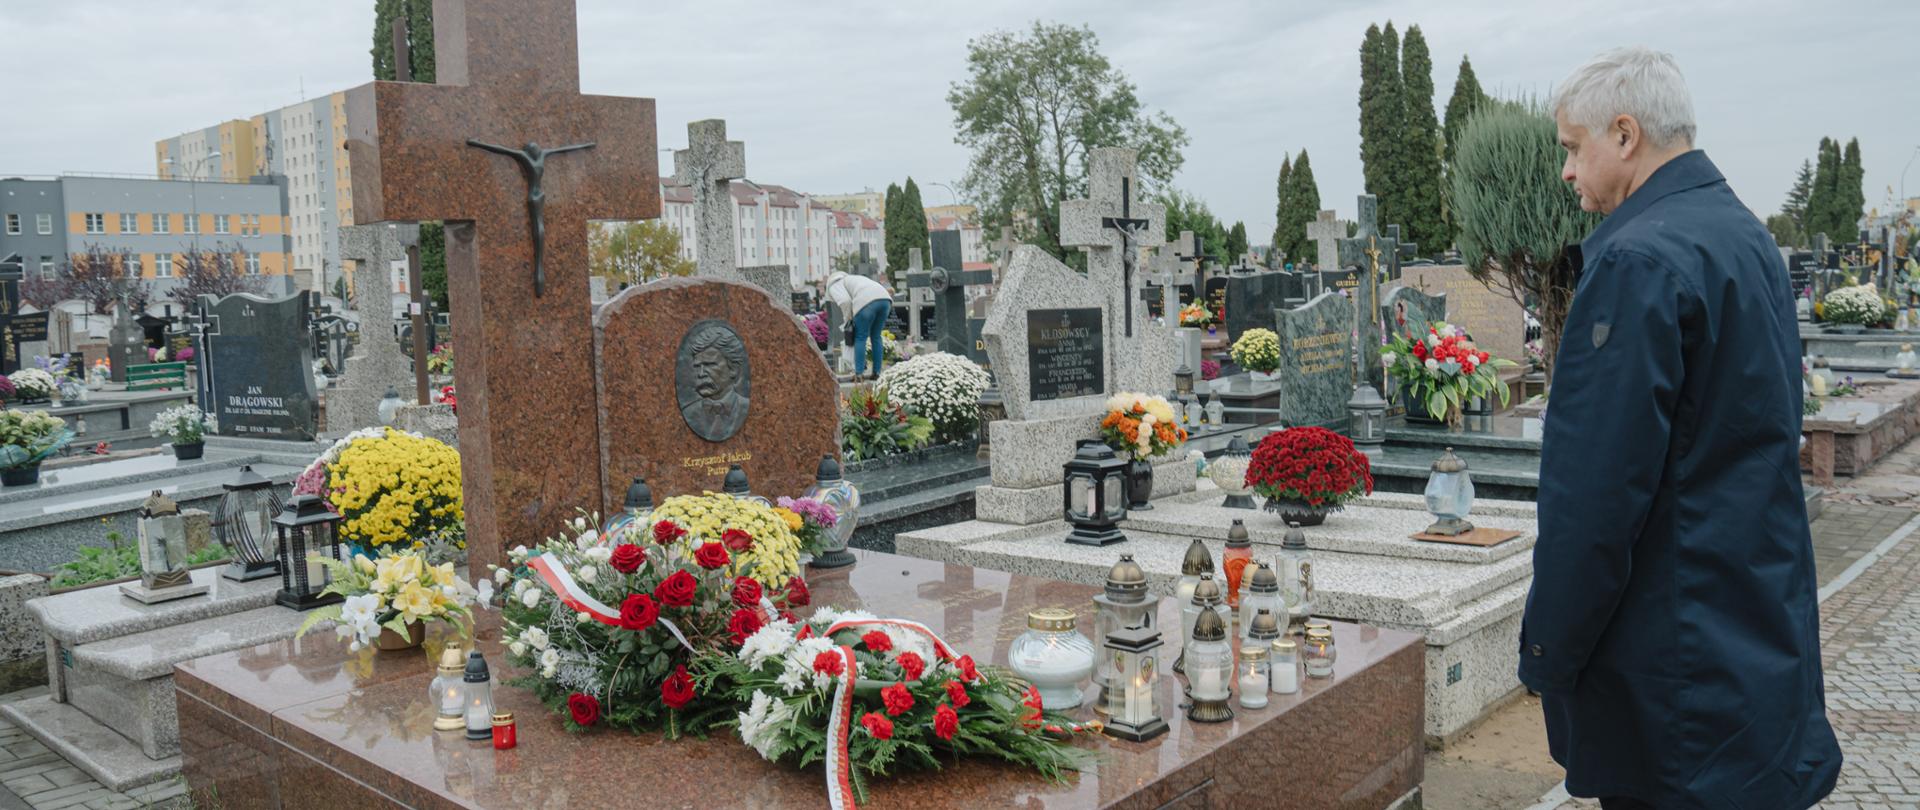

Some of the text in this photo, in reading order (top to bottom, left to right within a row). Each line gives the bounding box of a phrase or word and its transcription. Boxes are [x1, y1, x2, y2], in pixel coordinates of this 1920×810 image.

[247, 385, 263, 395] JAN
[229, 395, 284, 408] DRĄGOWSKI
[683, 453, 726, 468] Krzysztof
[707, 466, 731, 476] Putr
